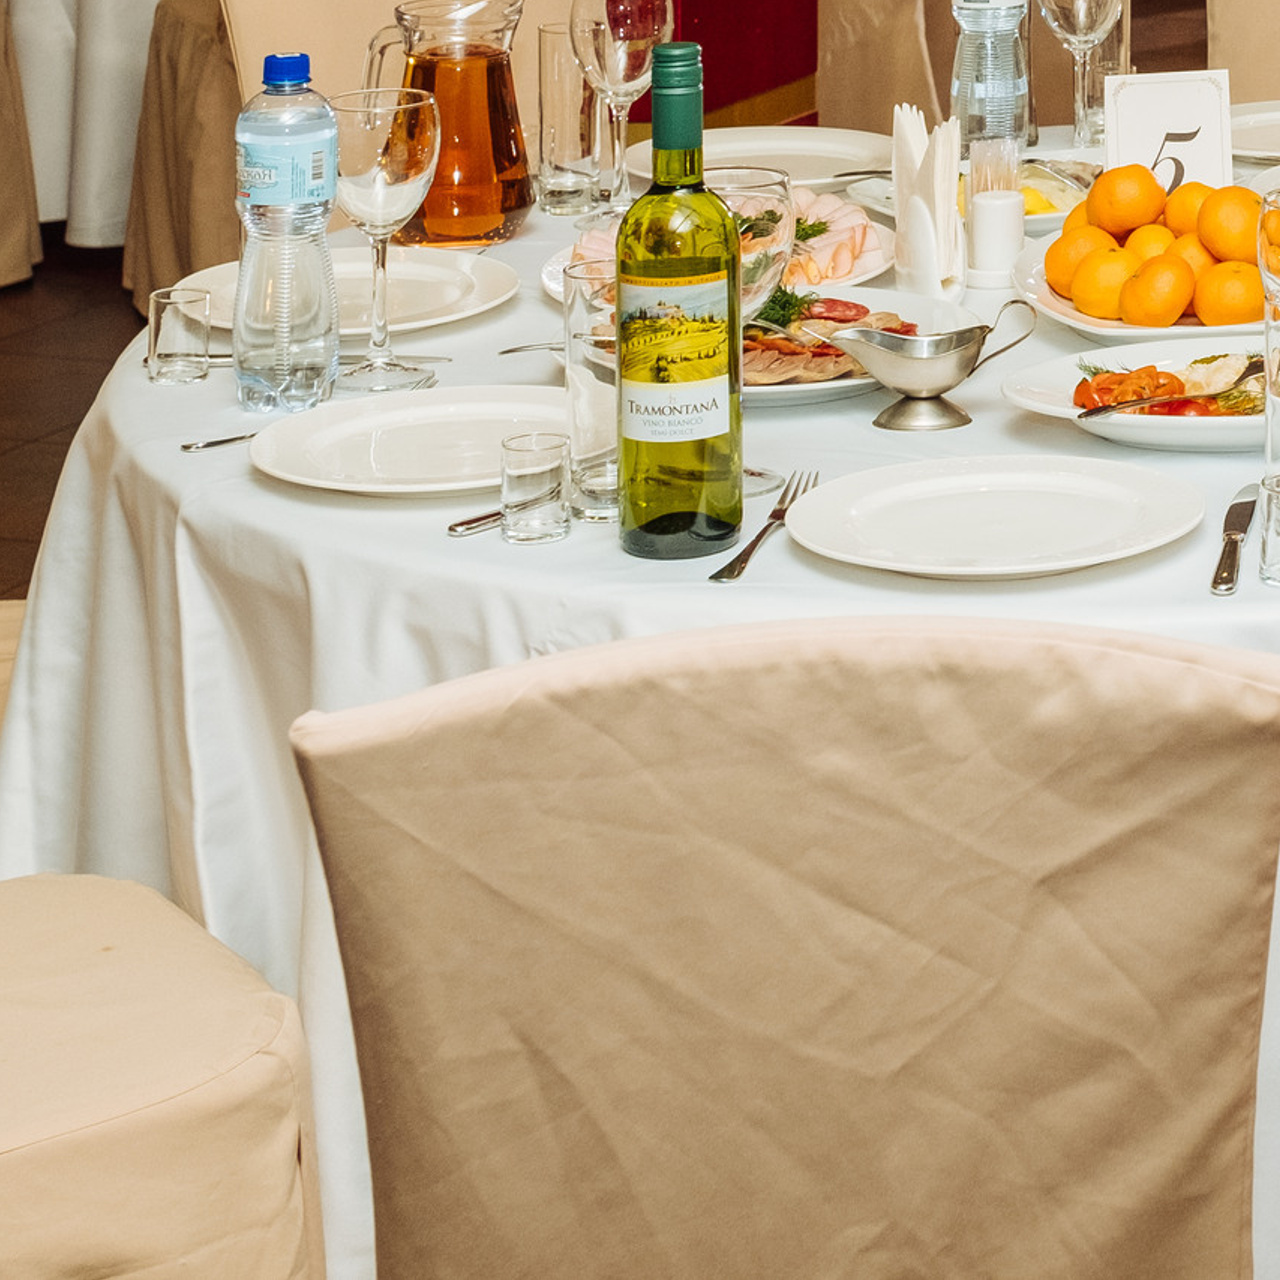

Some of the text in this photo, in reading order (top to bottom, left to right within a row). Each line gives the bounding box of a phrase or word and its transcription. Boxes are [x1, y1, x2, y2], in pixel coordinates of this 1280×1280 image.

[1151, 125, 1201, 198] 5
[627, 397, 719, 417] TRAMONTANA
[642, 416, 704, 428] VINO BIANCO
